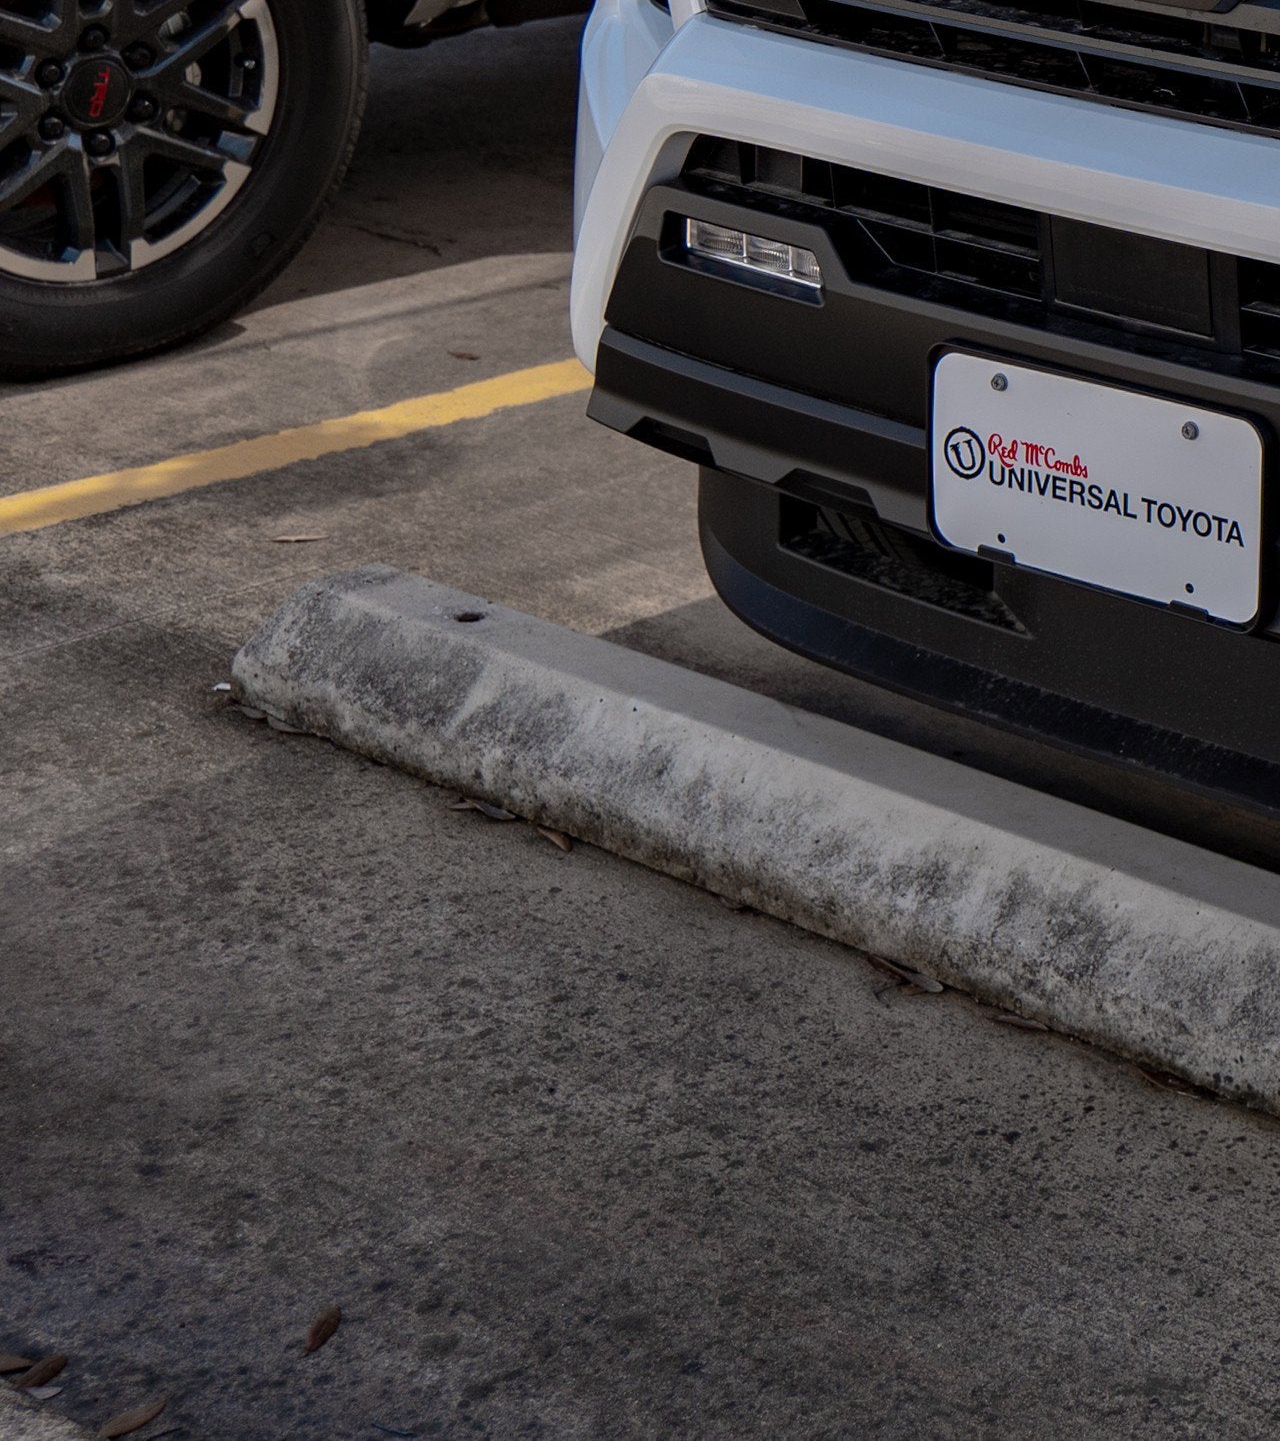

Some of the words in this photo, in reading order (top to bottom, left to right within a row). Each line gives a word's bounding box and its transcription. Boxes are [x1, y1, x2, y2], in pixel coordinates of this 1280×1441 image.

[988, 433, 1018, 468] Red
[1021, 440, 1089, 479] McCombs
[988, 460, 1138, 520] UNIVERSAL
[1141, 497, 1245, 548] TOYOTA
